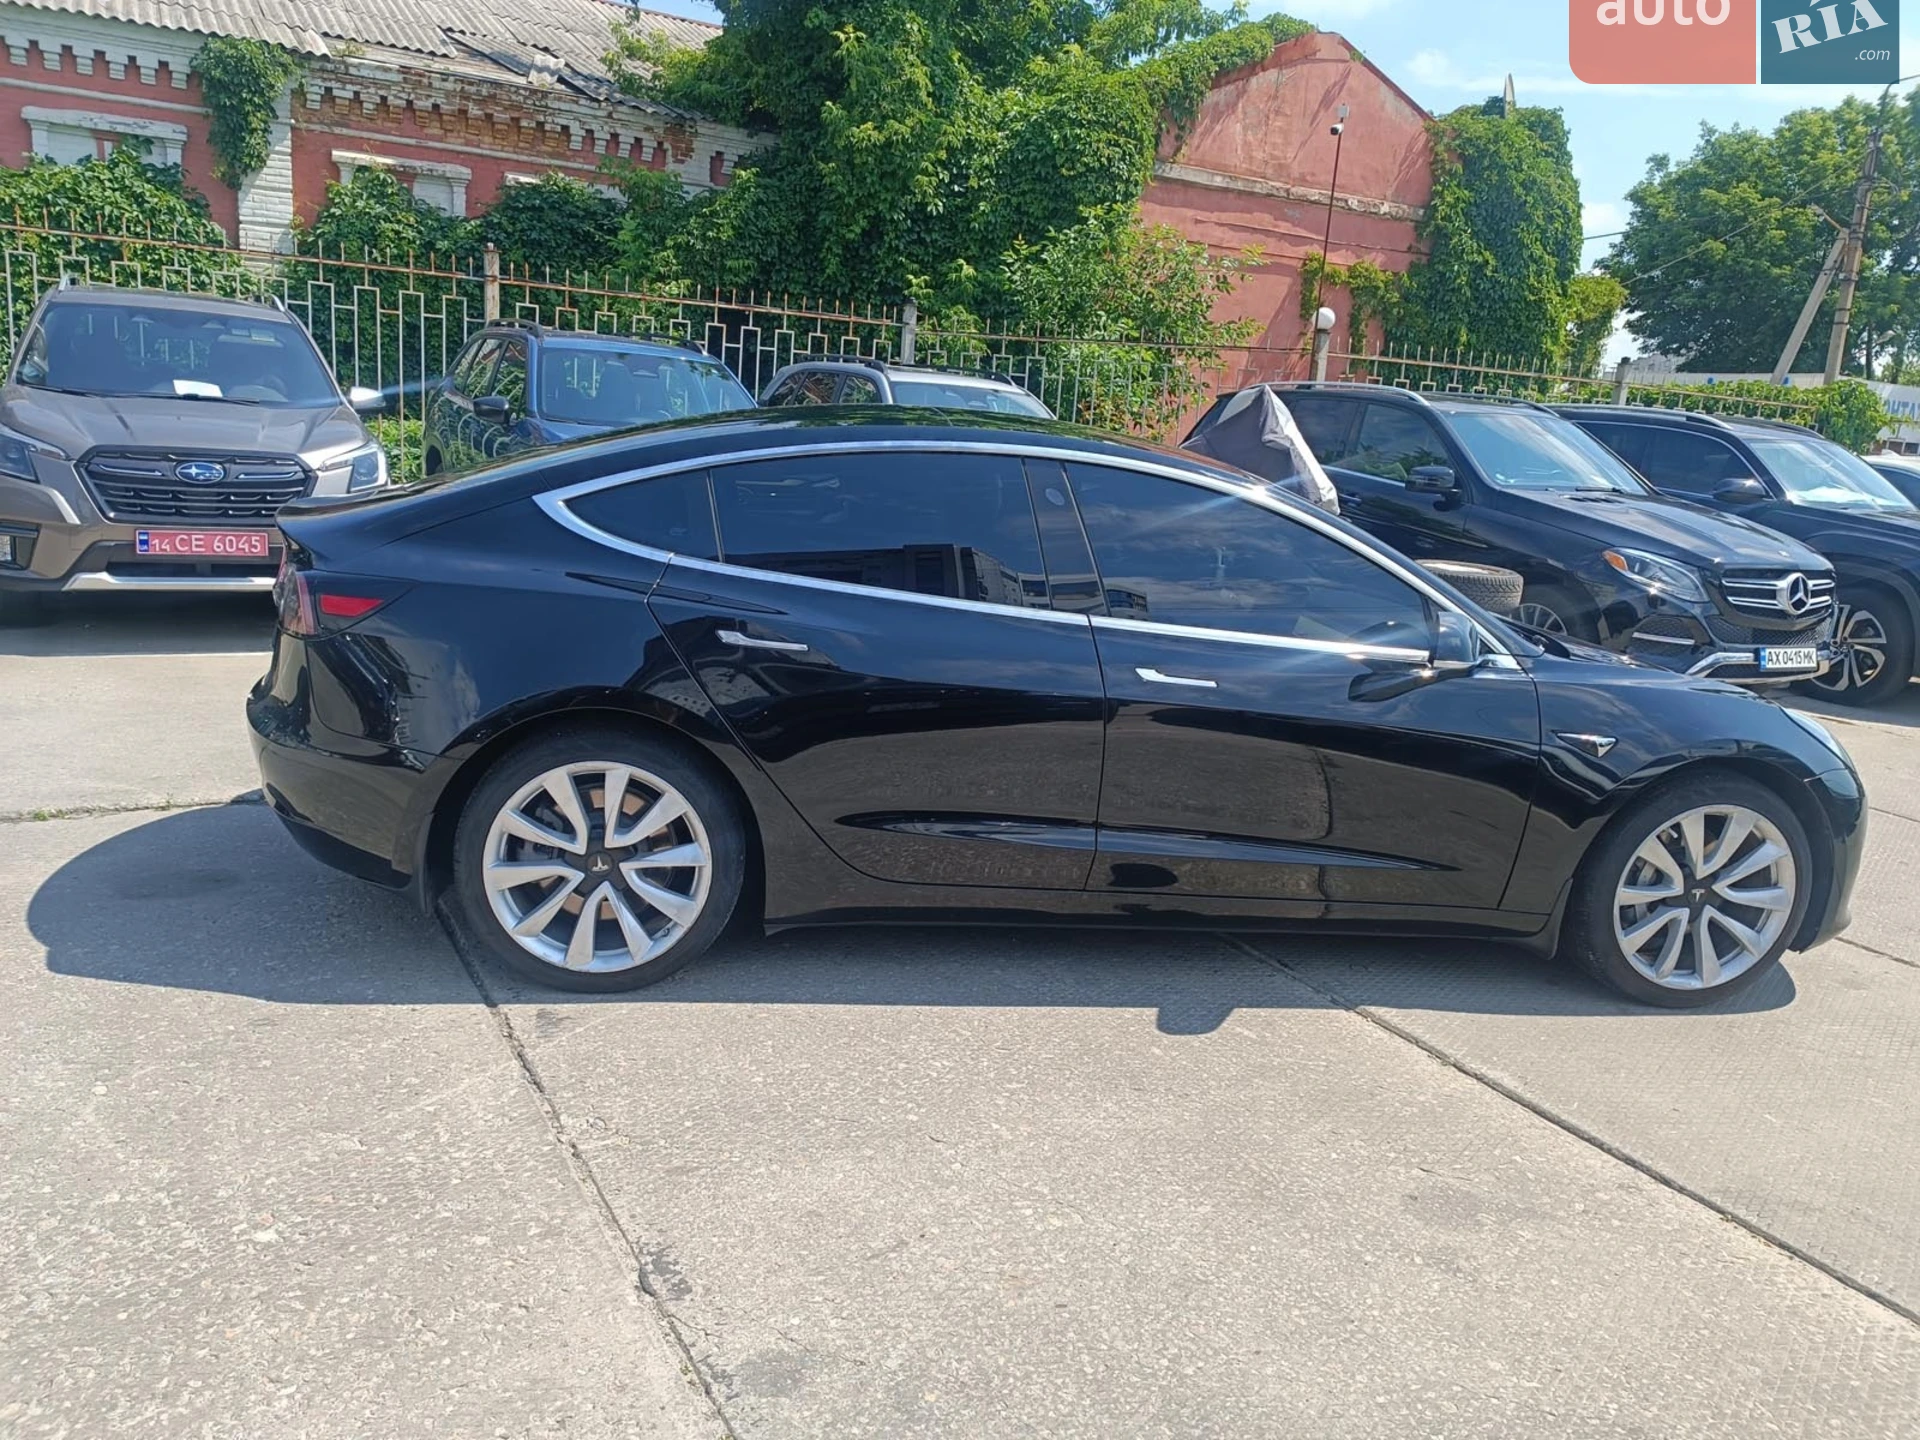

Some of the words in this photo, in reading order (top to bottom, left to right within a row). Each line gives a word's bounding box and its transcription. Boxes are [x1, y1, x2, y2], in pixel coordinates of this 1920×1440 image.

[151, 538, 171, 552] 14
[175, 535, 206, 552] CE
[213, 535, 261, 553] 6045
